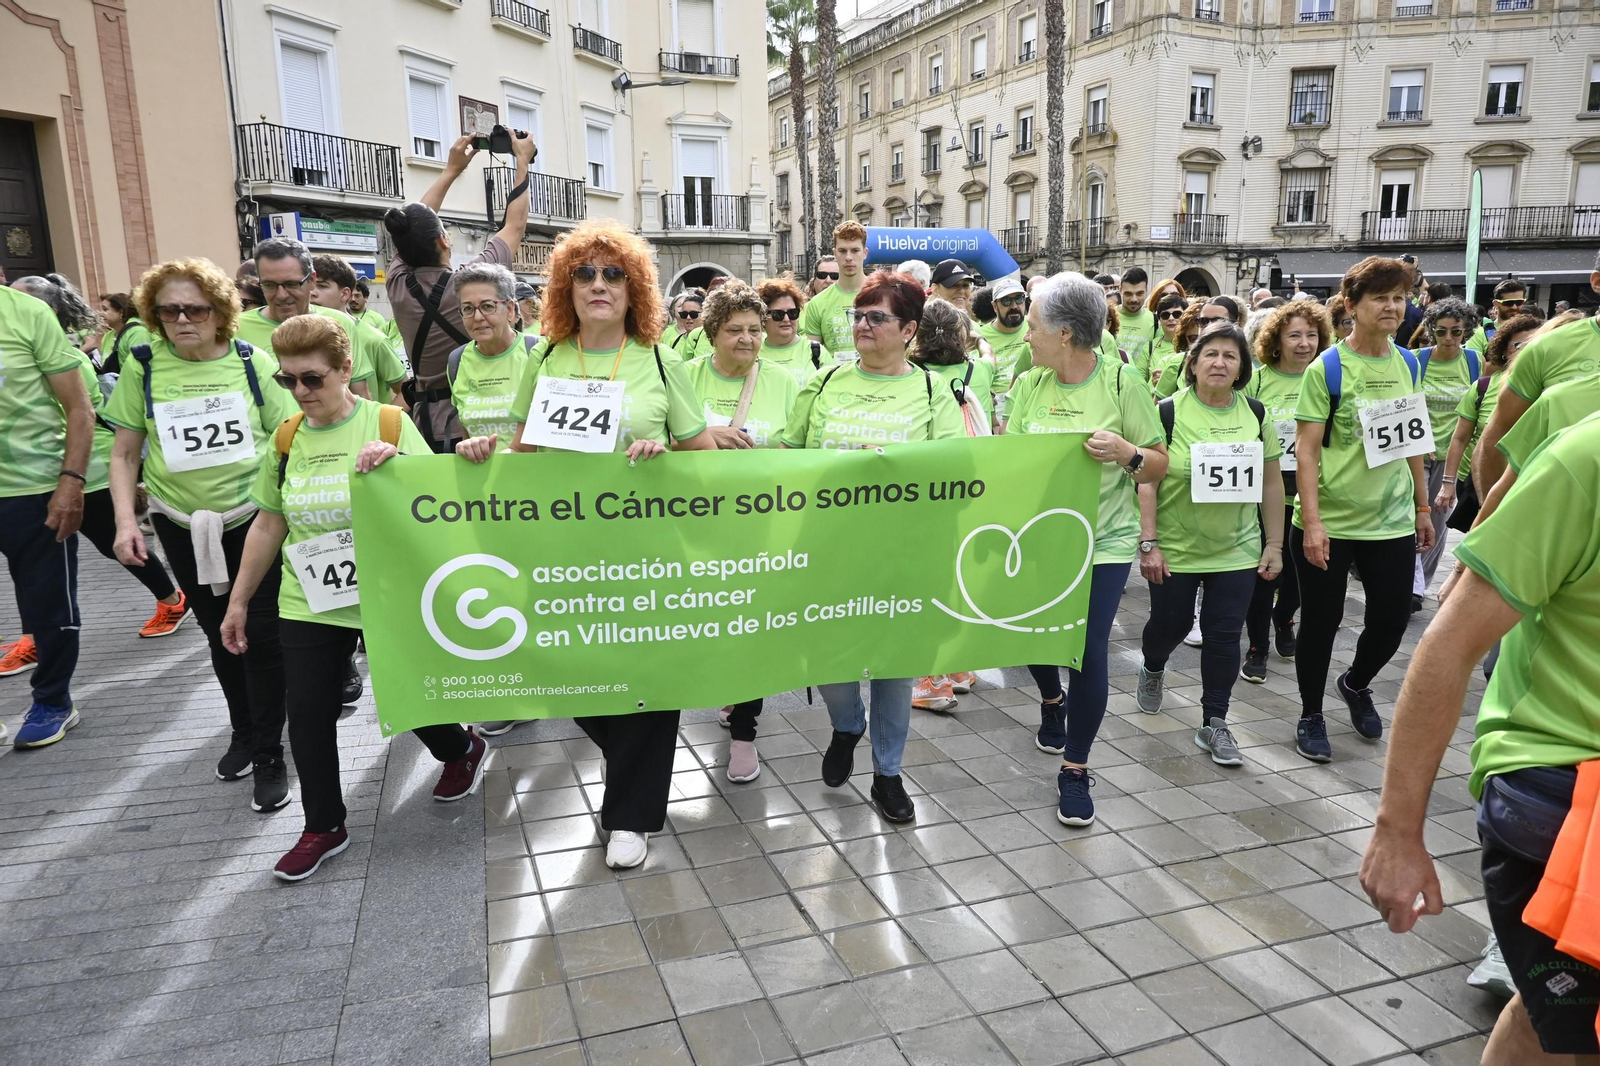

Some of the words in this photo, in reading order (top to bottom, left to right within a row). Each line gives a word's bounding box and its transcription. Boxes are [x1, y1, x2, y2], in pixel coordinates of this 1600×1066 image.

[878, 235, 927, 250] Huelva
[932, 236, 979, 254] original
[466, 396, 480, 405] En
[463, 407, 509, 419] contra
[541, 400, 550, 413] 1
[548, 406, 611, 435] 424
[853, 410, 913, 425] marcha
[1272, 408, 1285, 416] En
[168, 425, 177, 440] 1
[183, 420, 244, 452] 525
[825, 421, 887, 441] contra
[890, 428, 909, 443] el
[1368, 426, 1374, 439] 1
[1377, 417, 1425, 449] 518
[290, 477, 306, 488] En
[1199, 462, 1205, 475] 1
[1208, 466, 1254, 487] 511
[286, 489, 345, 505] contra
[411, 494, 540, 524] Contra
[550, 491, 586, 521] el
[595, 490, 726, 520] Cáncer
[735, 485, 807, 515] solo
[816, 482, 920, 509] somos
[929, 479, 986, 501] uno
[305, 564, 317, 579] 1
[532, 557, 682, 583] asociación
[689, 549, 809, 581] española
[534, 592, 626, 615] contra
[633, 590, 656, 611] el
[664, 587, 757, 610] cáncer
[536, 629, 571, 648] en
[577, 622, 720, 645] Villanueva
[727, 615, 760, 635] de
[765, 611, 798, 631] los
[804, 595, 923, 623] Castillejos
[442, 676, 467, 687] 900
[471, 675, 496, 685] 100
[498, 673, 523, 684] 036
[443, 683, 629, 699] asociacioncontraelcancer.es
